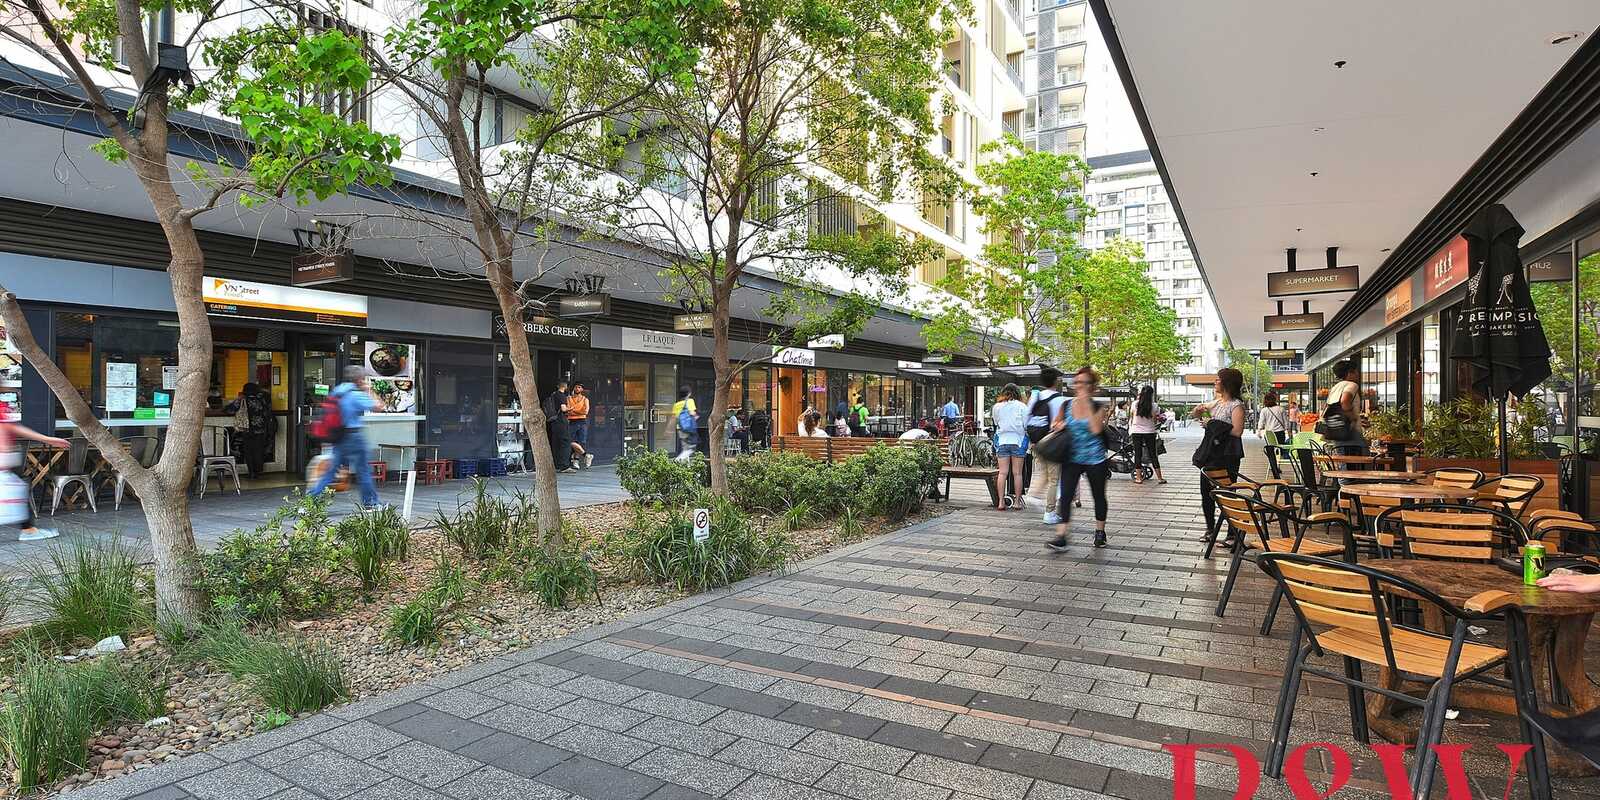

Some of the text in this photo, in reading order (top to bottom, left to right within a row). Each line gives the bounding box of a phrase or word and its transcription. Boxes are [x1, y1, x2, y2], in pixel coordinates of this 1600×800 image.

[1286, 275, 1338, 285] SUPERMARKET
[224, 283, 238, 293] VN
[210, 303, 237, 311] CATERING
[551, 326, 579, 337] CREEK
[642, 334, 652, 343] LE
[782, 350, 813, 365] Chatime
